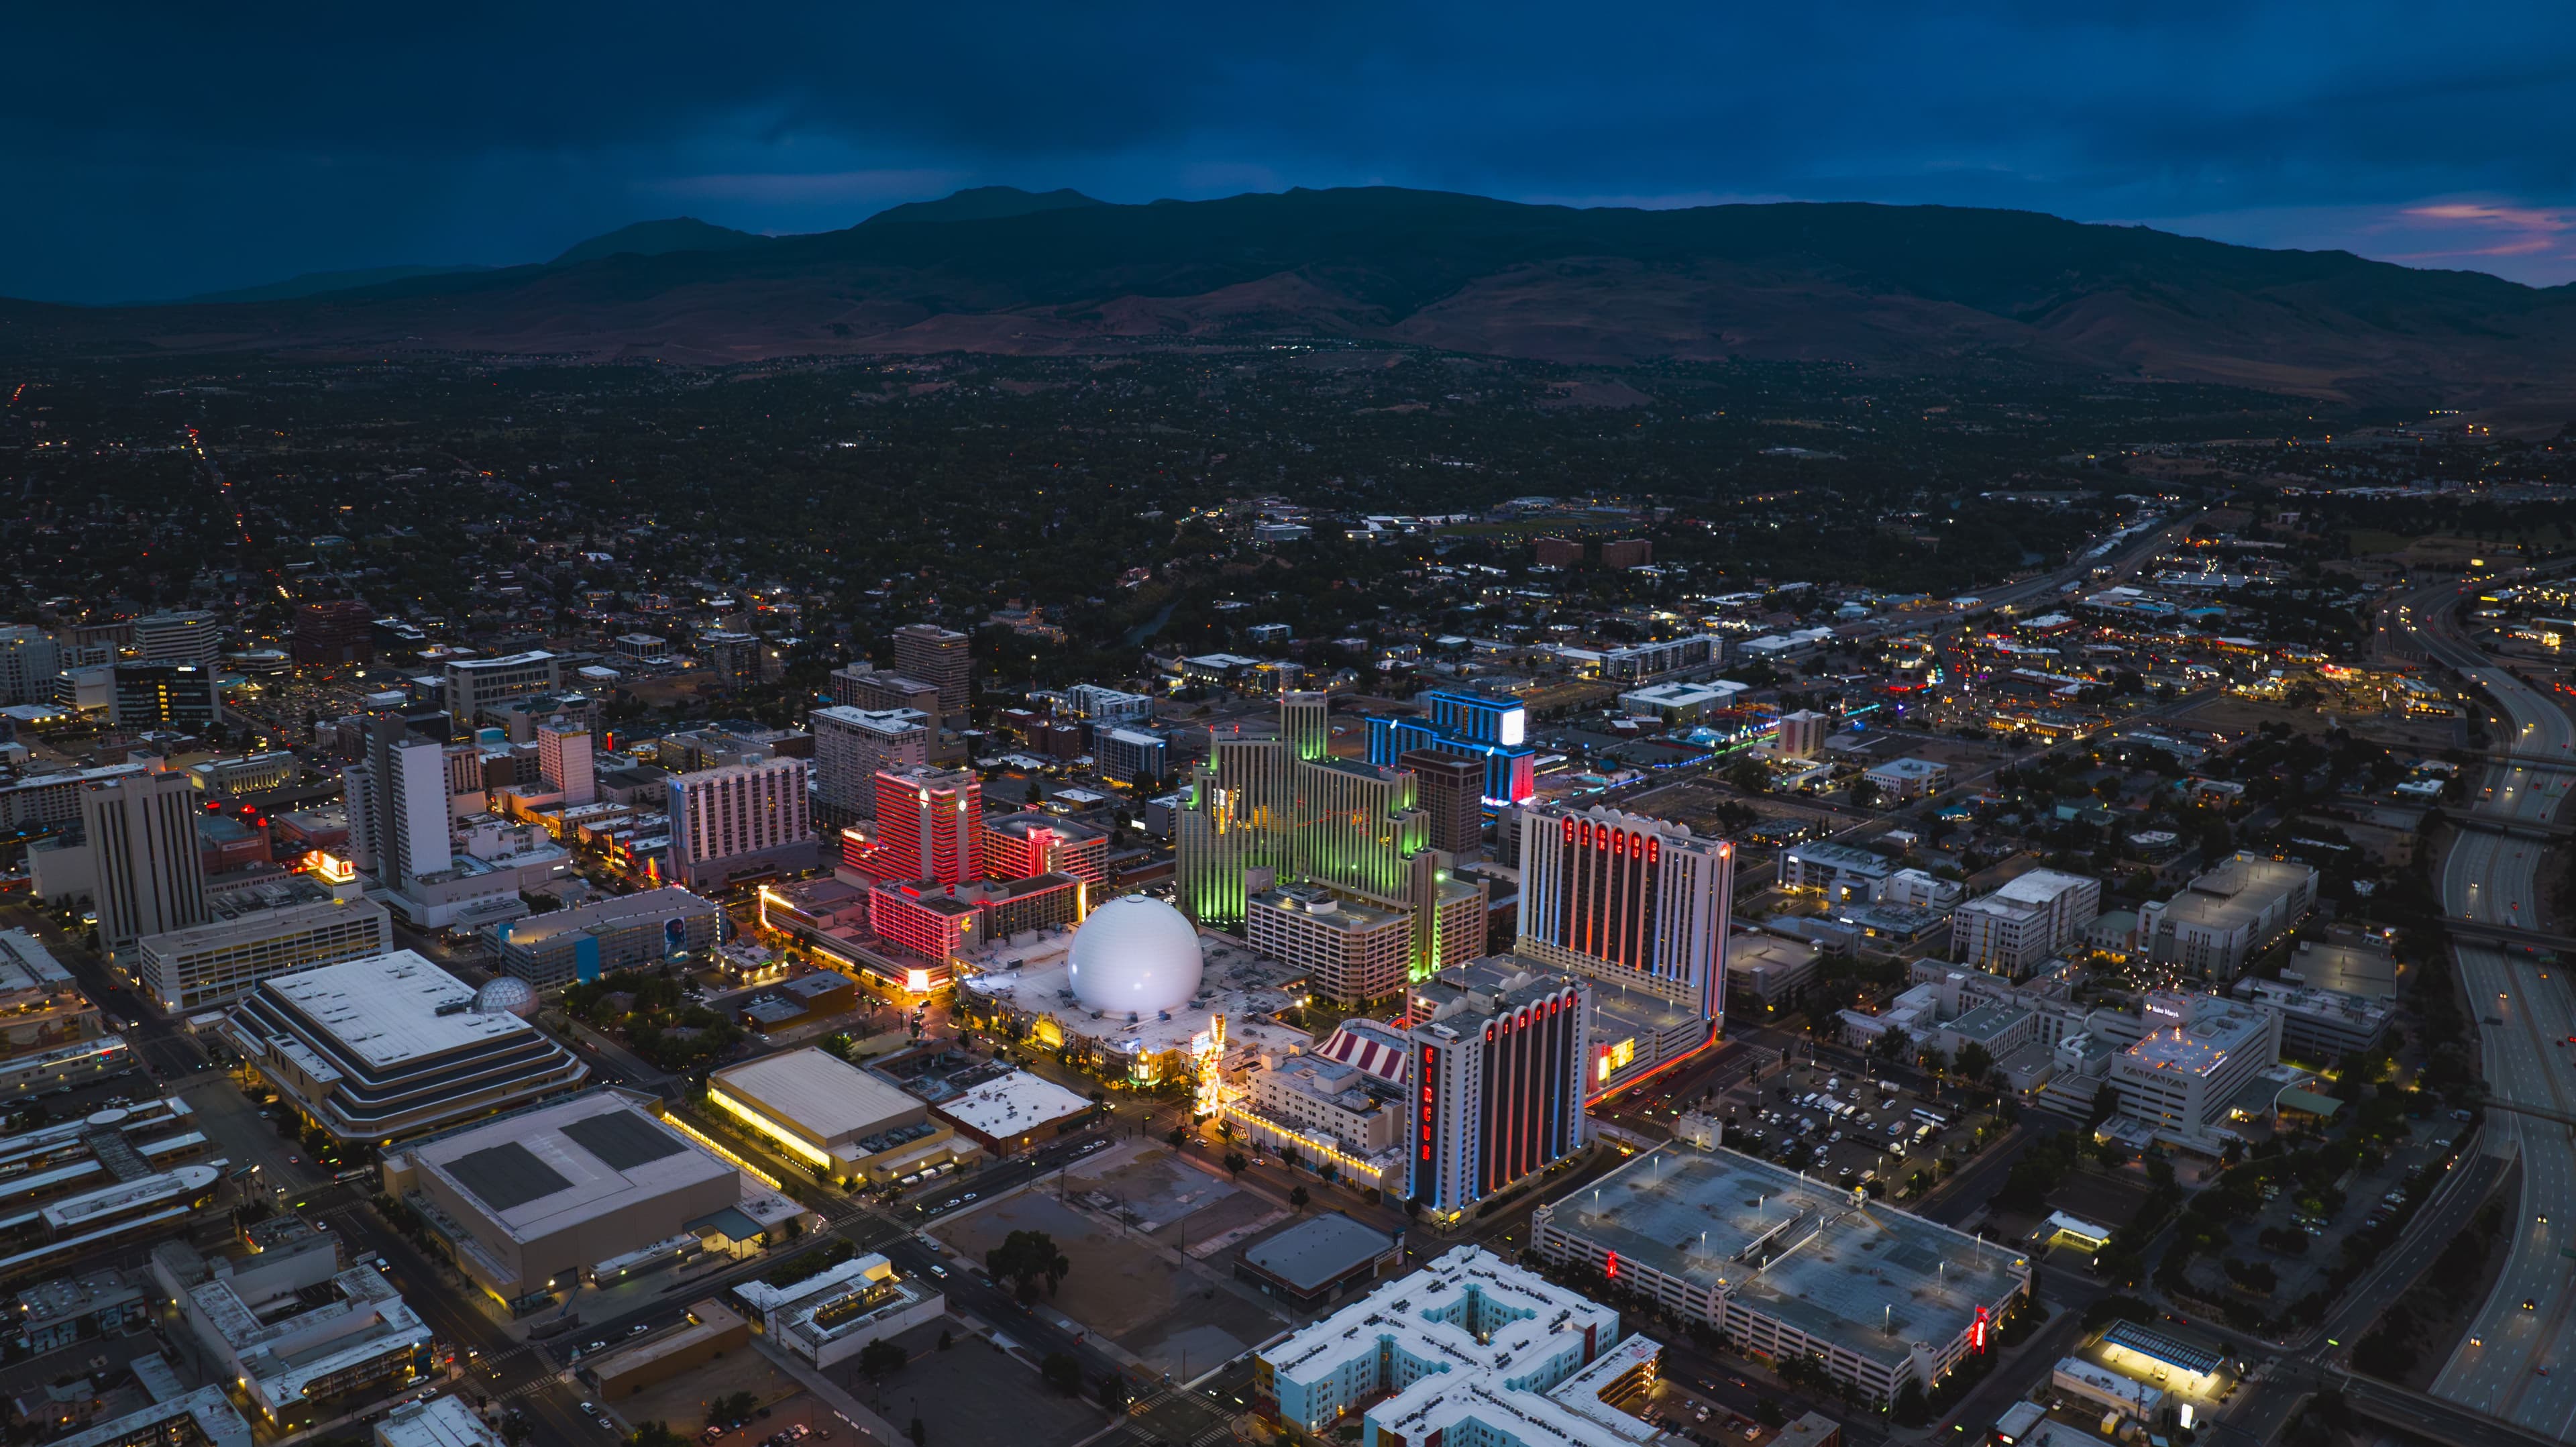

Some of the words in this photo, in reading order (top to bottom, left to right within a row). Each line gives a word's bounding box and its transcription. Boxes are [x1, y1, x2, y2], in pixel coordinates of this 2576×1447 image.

[1567, 822, 1657, 851] CIRCUS
[1567, 833, 1656, 863] CIRCUS
[1487, 996, 1572, 1041] CIRCUS
[1422, 1047, 1434, 1161] CIRCUS
